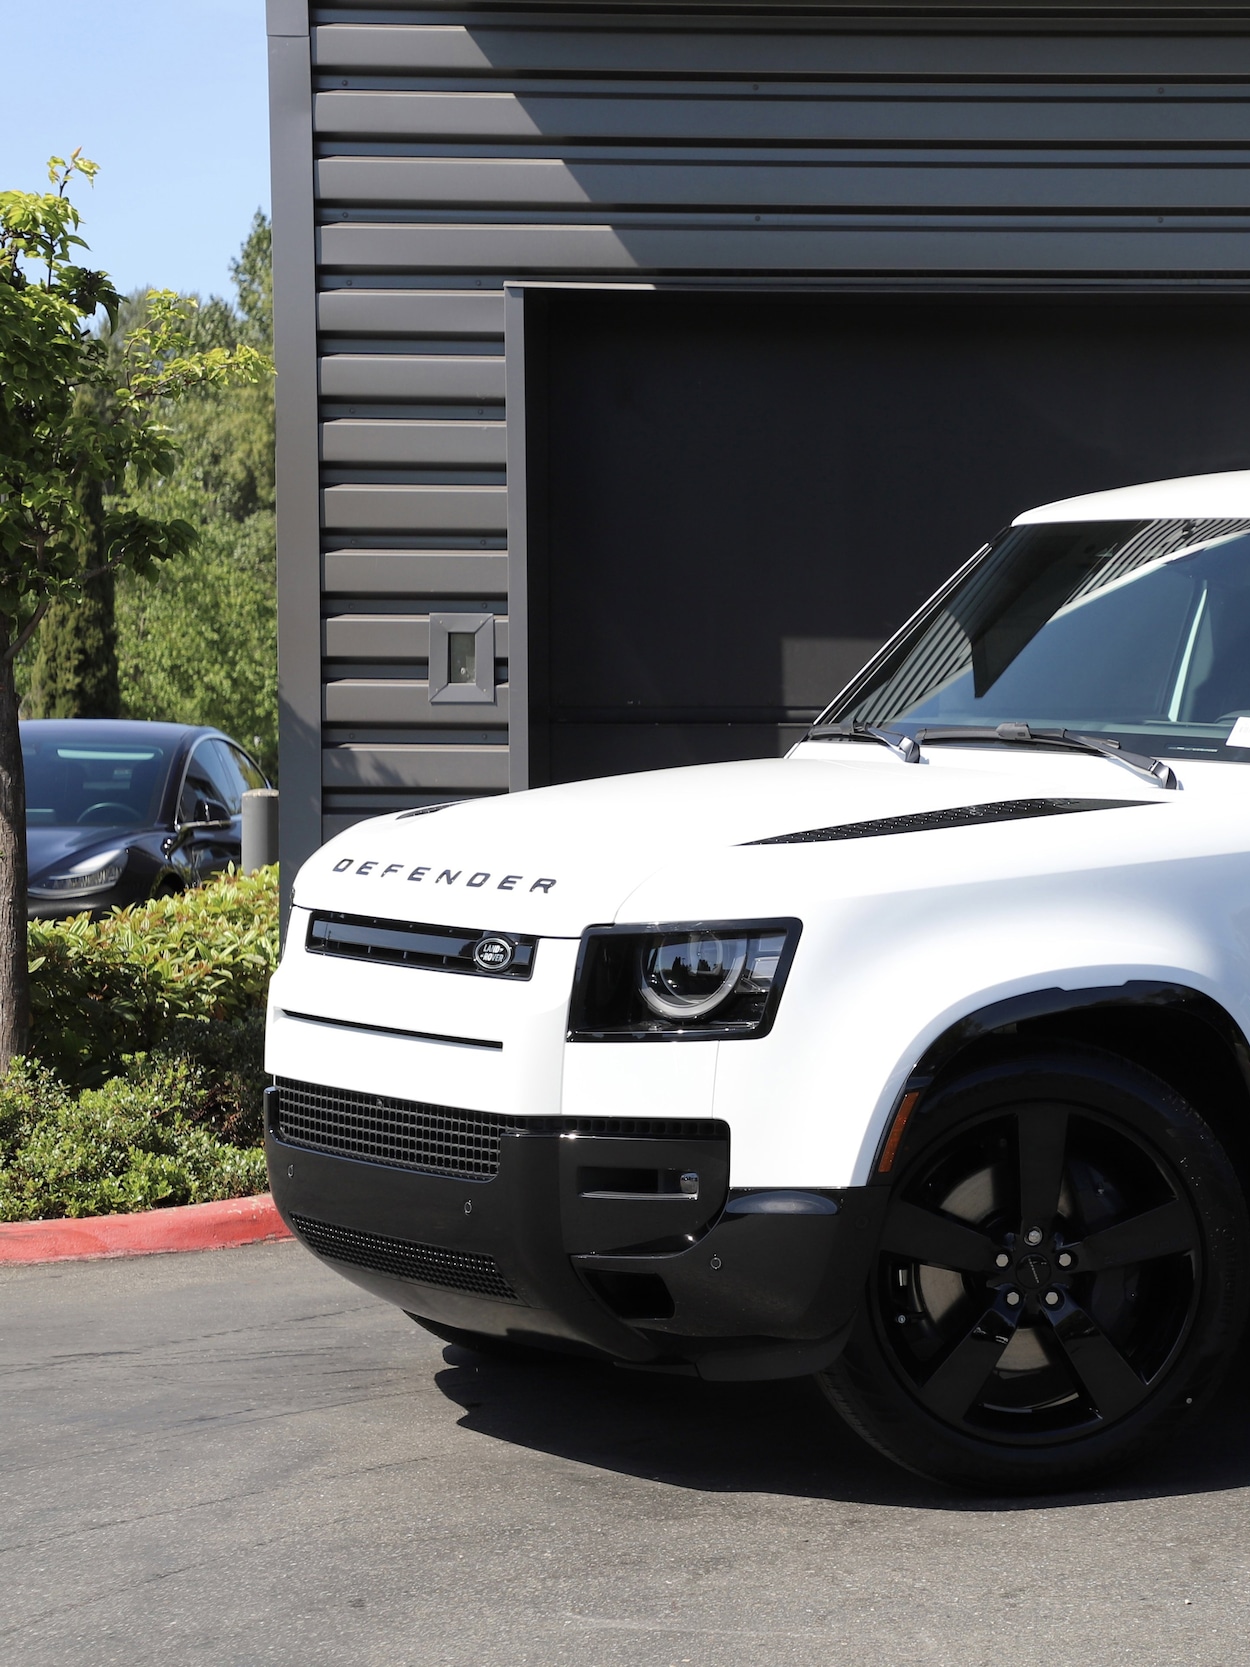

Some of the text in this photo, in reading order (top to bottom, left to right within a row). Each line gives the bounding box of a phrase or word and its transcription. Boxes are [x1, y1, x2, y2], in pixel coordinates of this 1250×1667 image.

[332, 858, 557, 894] DEFENDER
[483, 944, 501, 954] LAND
[482, 953, 504, 962] ROVER
